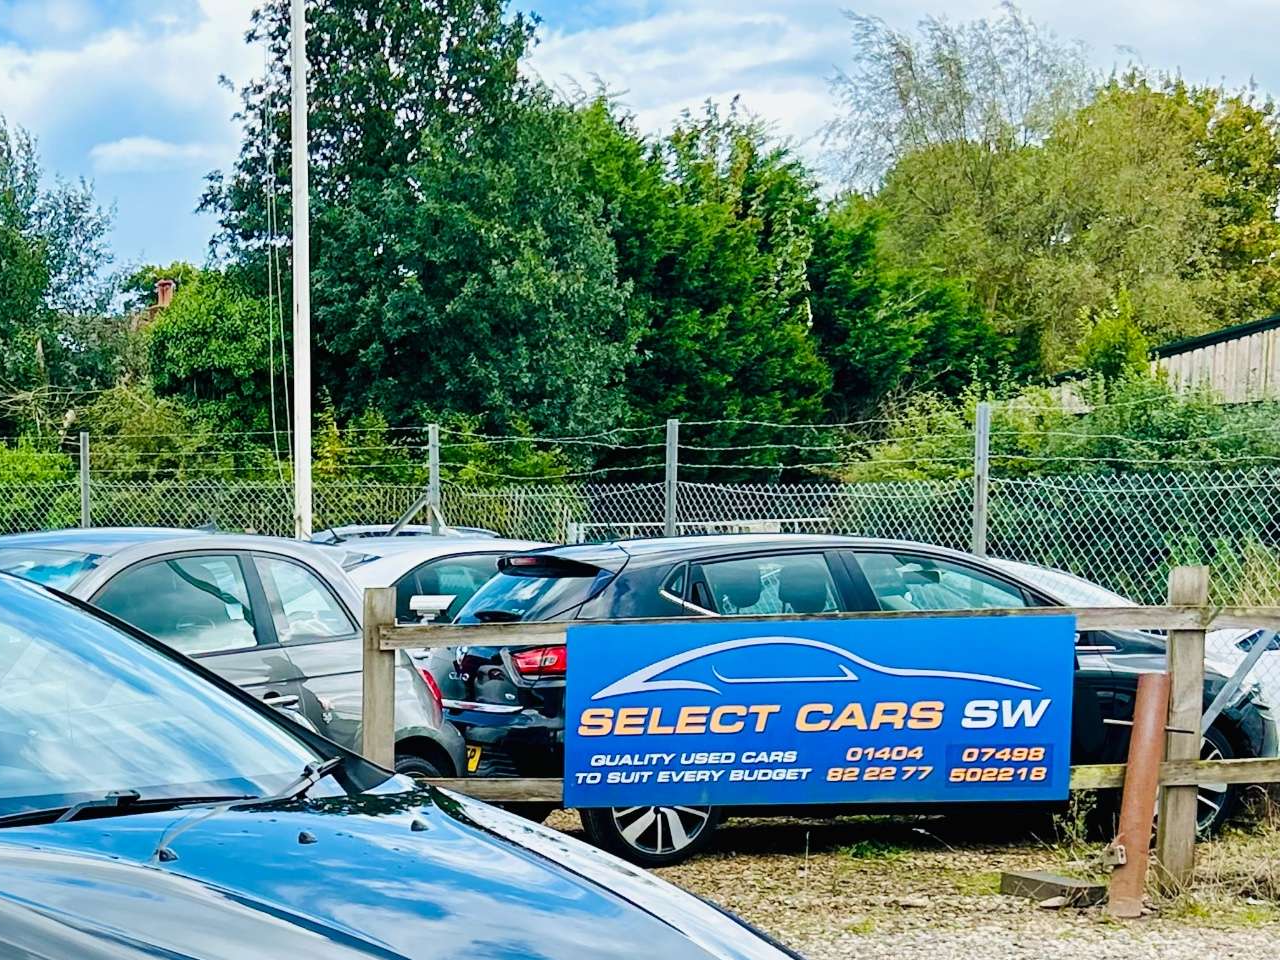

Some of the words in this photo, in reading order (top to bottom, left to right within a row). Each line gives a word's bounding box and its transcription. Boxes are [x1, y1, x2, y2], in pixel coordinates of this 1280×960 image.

[577, 704, 781, 737] SELECT
[795, 701, 945, 732] CARS
[961, 699, 1051, 729] SW
[590, 753, 675, 767] QUALITY
[680, 752, 736, 765] USED
[741, 751, 797, 763] CARS
[846, 746, 924, 761] 01404
[962, 747, 1045, 762] 07498
[575, 772, 601, 784] TO
[607, 771, 653, 784] SUIT
[657, 770, 725, 783] EVERY
[729, 768, 812, 782] BUDGET
[826, 767, 859, 782] 82
[863, 767, 897, 781] 22
[901, 766, 934, 780] 77
[949, 767, 1048, 782] 502218
